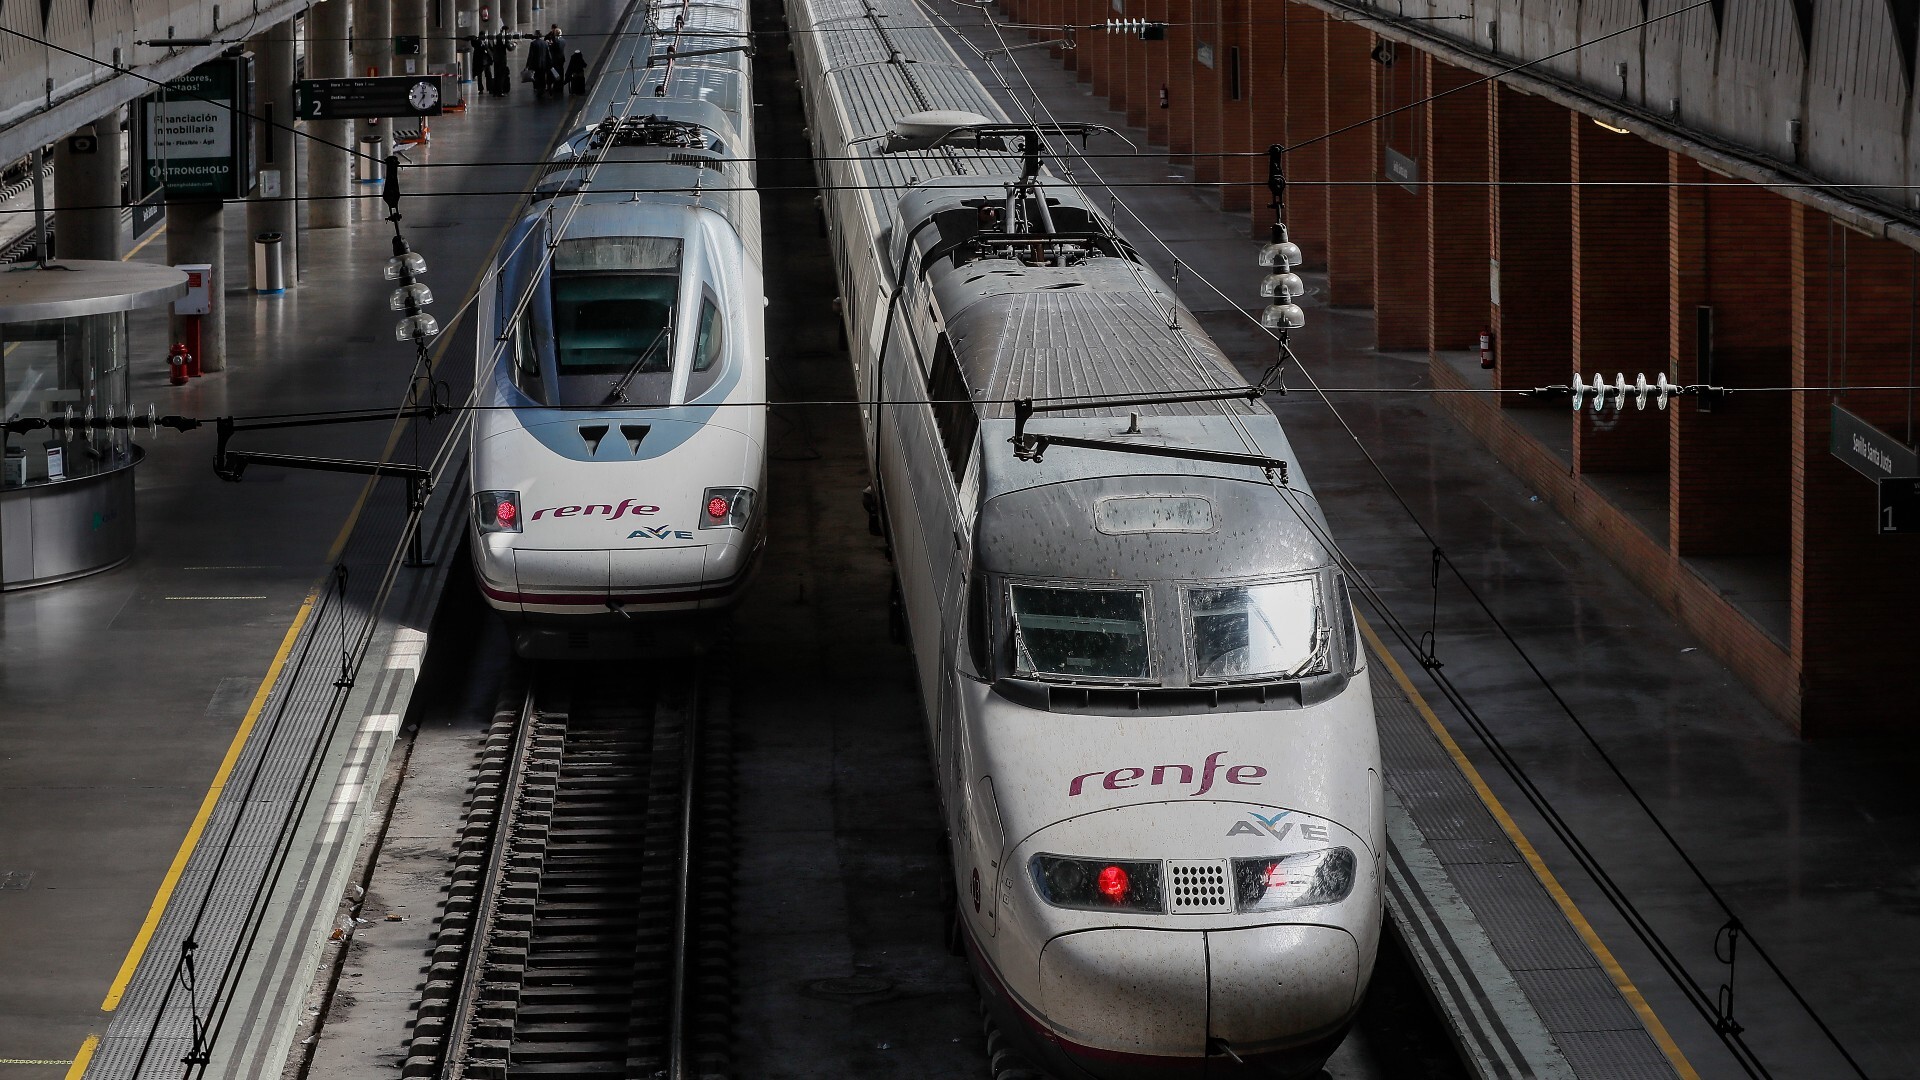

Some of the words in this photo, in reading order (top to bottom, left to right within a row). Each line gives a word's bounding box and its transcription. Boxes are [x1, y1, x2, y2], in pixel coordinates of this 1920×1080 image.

[413, 45, 419, 54] 2
[312, 100, 322, 116] 2
[155, 125, 214, 135] nmobiliaria
[162, 165, 229, 176] STRONGHOLD
[1853, 432, 1867, 458] Sevilla
[1867, 441, 1880, 466] Santa
[1880, 450, 1892, 474] Justa
[531, 498, 660, 521] renfe
[1882, 506, 1897, 531] 1
[626, 525, 694, 540] AVE
[1068, 750, 1268, 797] renfe
[1225, 811, 1329, 842] AVE
